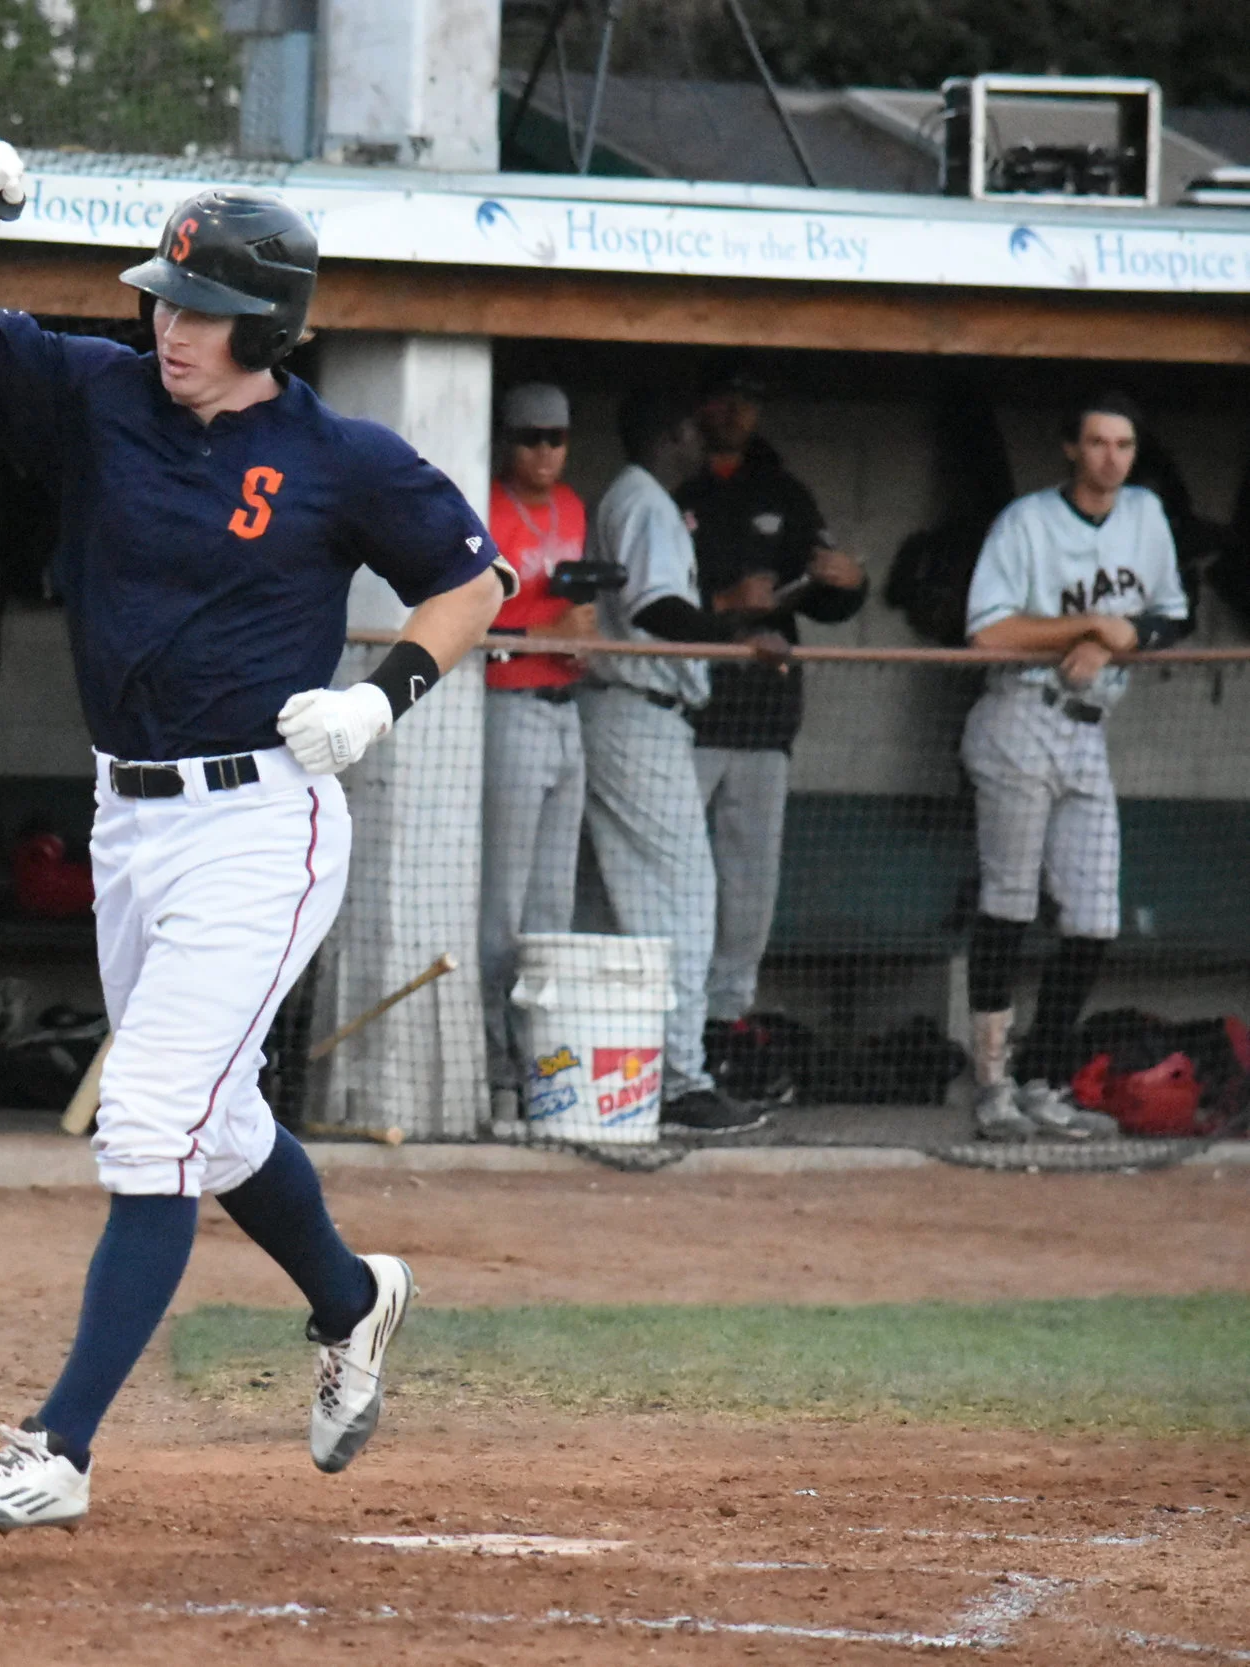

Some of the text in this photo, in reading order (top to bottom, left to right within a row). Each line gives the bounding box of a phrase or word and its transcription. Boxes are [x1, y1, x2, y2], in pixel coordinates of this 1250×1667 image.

[171, 217, 199, 262] S
[566, 208, 868, 273] Hospice by the Bay
[1094, 232, 1236, 288] Hospice
[227, 466, 285, 540] S
